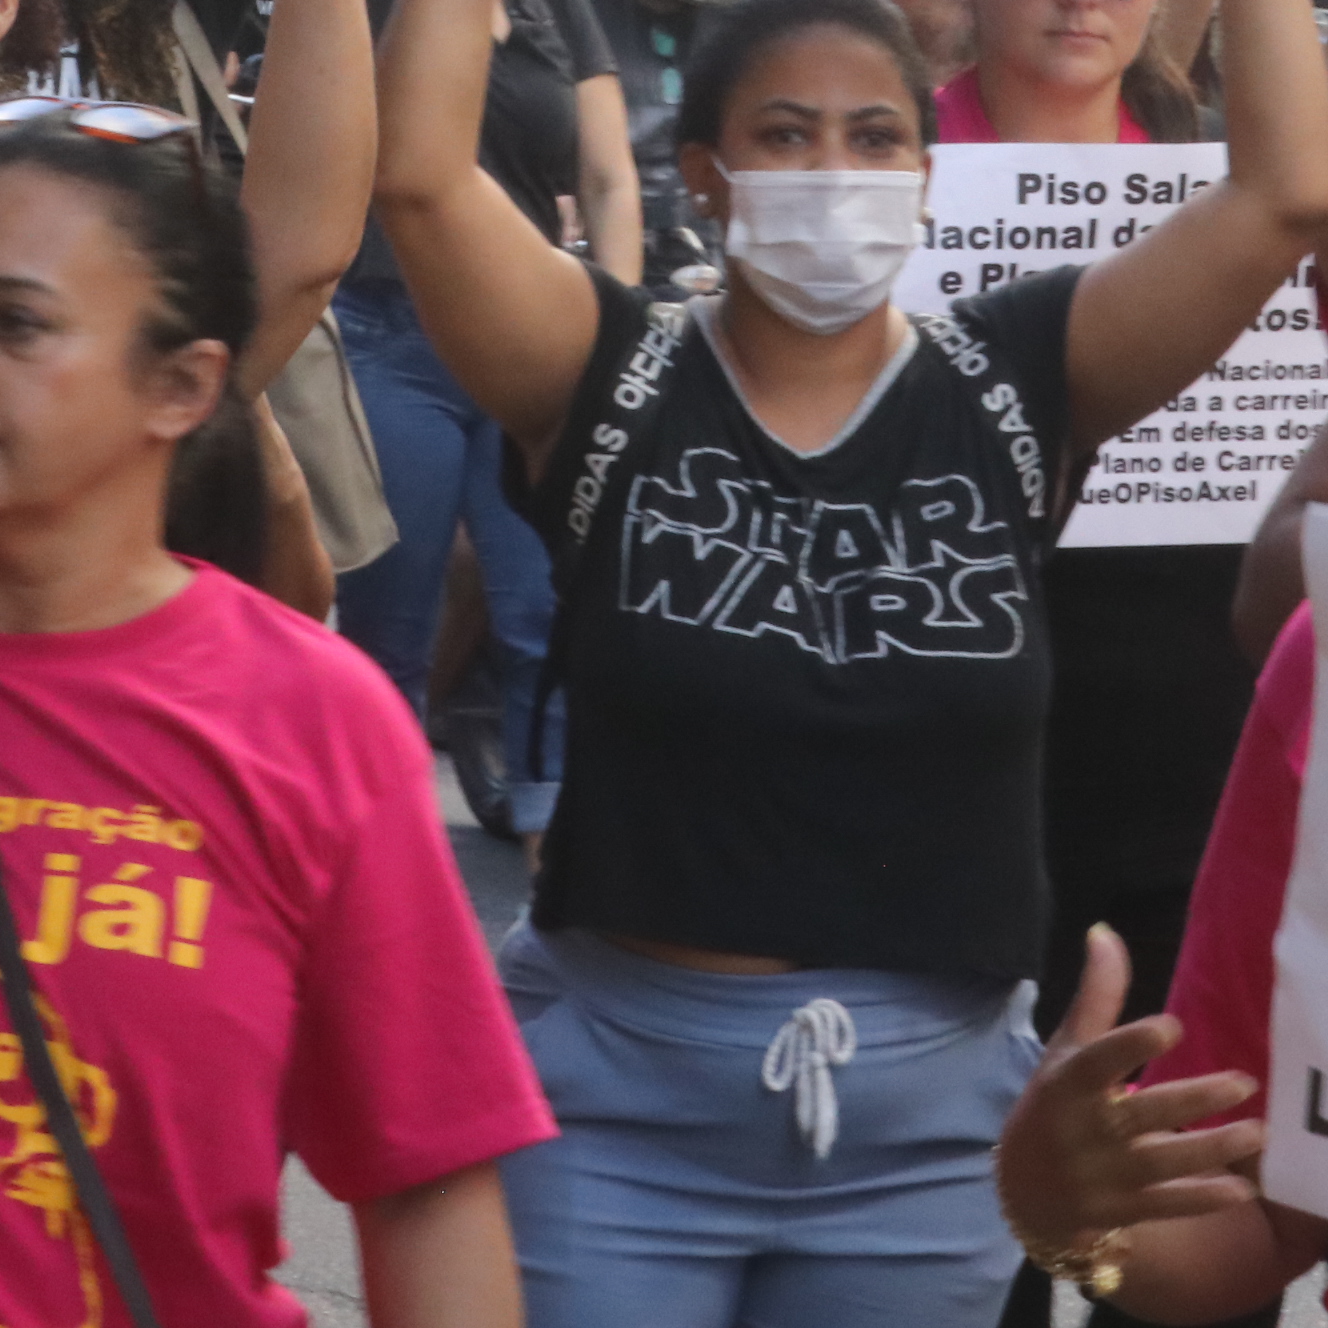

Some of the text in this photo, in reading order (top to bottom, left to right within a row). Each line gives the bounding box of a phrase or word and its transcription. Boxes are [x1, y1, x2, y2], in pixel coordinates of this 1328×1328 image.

[1017, 173, 1108, 207] Piso
[939, 273, 963, 294] e
[1173, 421, 1264, 443] defesa
[1278, 421, 1326, 442] dos
[1209, 397, 1223, 411] a
[568, 423, 629, 544] DIDAS
[980, 382, 1046, 519] ADIDAS
[1174, 450, 1206, 473] de
[625, 447, 1017, 575] STAR
[618, 510, 1029, 664] WARS
[20, 852, 214, 970] já!
